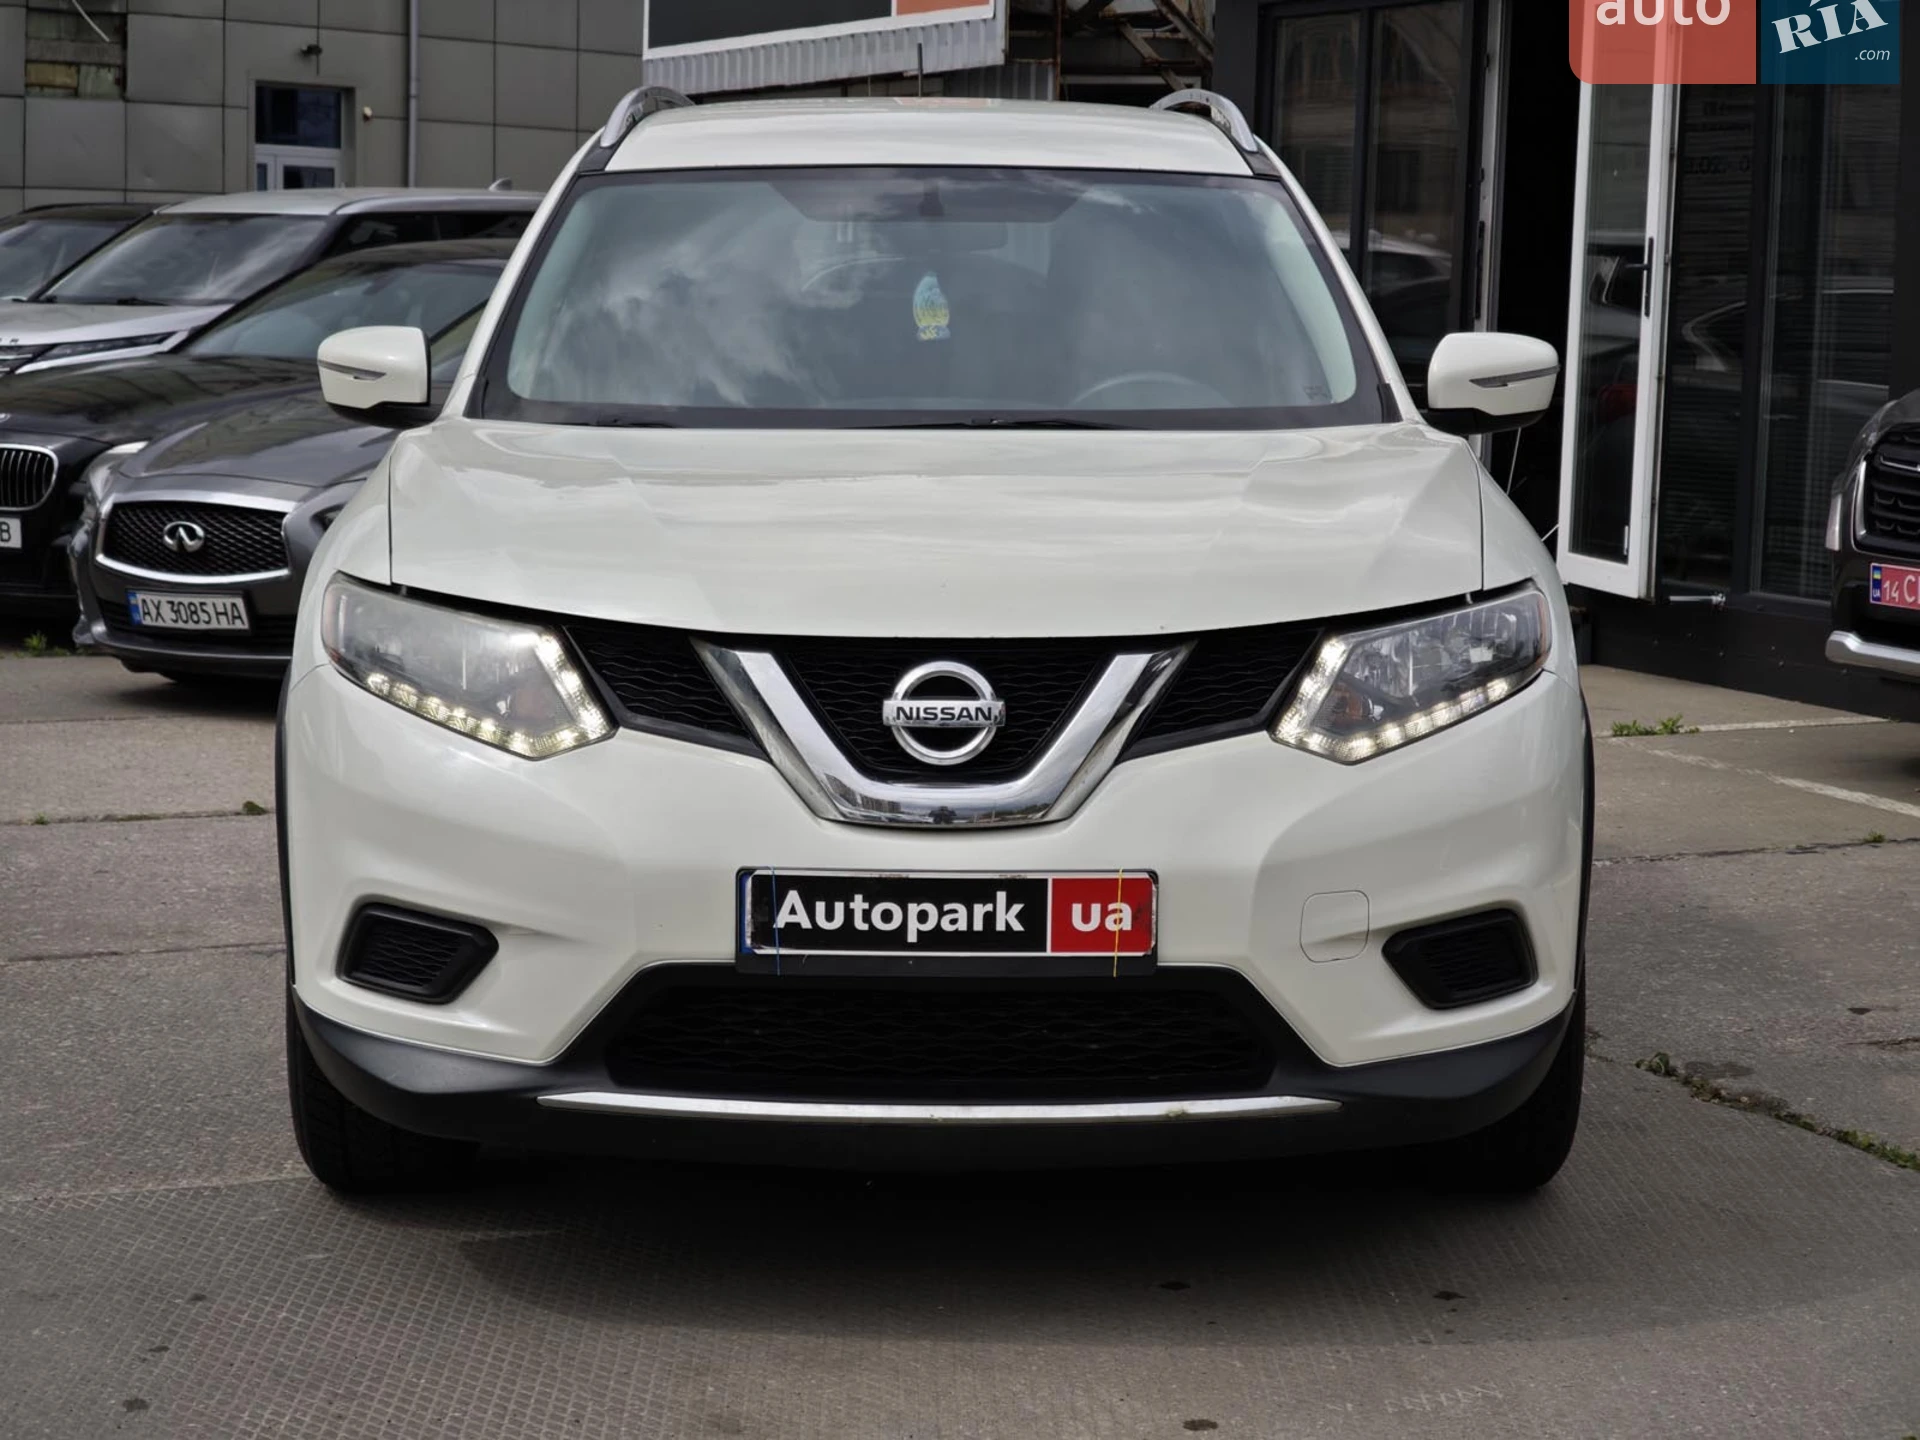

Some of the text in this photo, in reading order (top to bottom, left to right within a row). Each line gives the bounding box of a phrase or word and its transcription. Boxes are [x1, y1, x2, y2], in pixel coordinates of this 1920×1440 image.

[1872, 589, 1881, 597] UA
[1883, 575, 1920, 604] 14 C
[141, 598, 246, 626] AX 3085 HA
[896, 706, 992, 721] NISSAN
[773, 889, 1132, 943] Autopark ua
